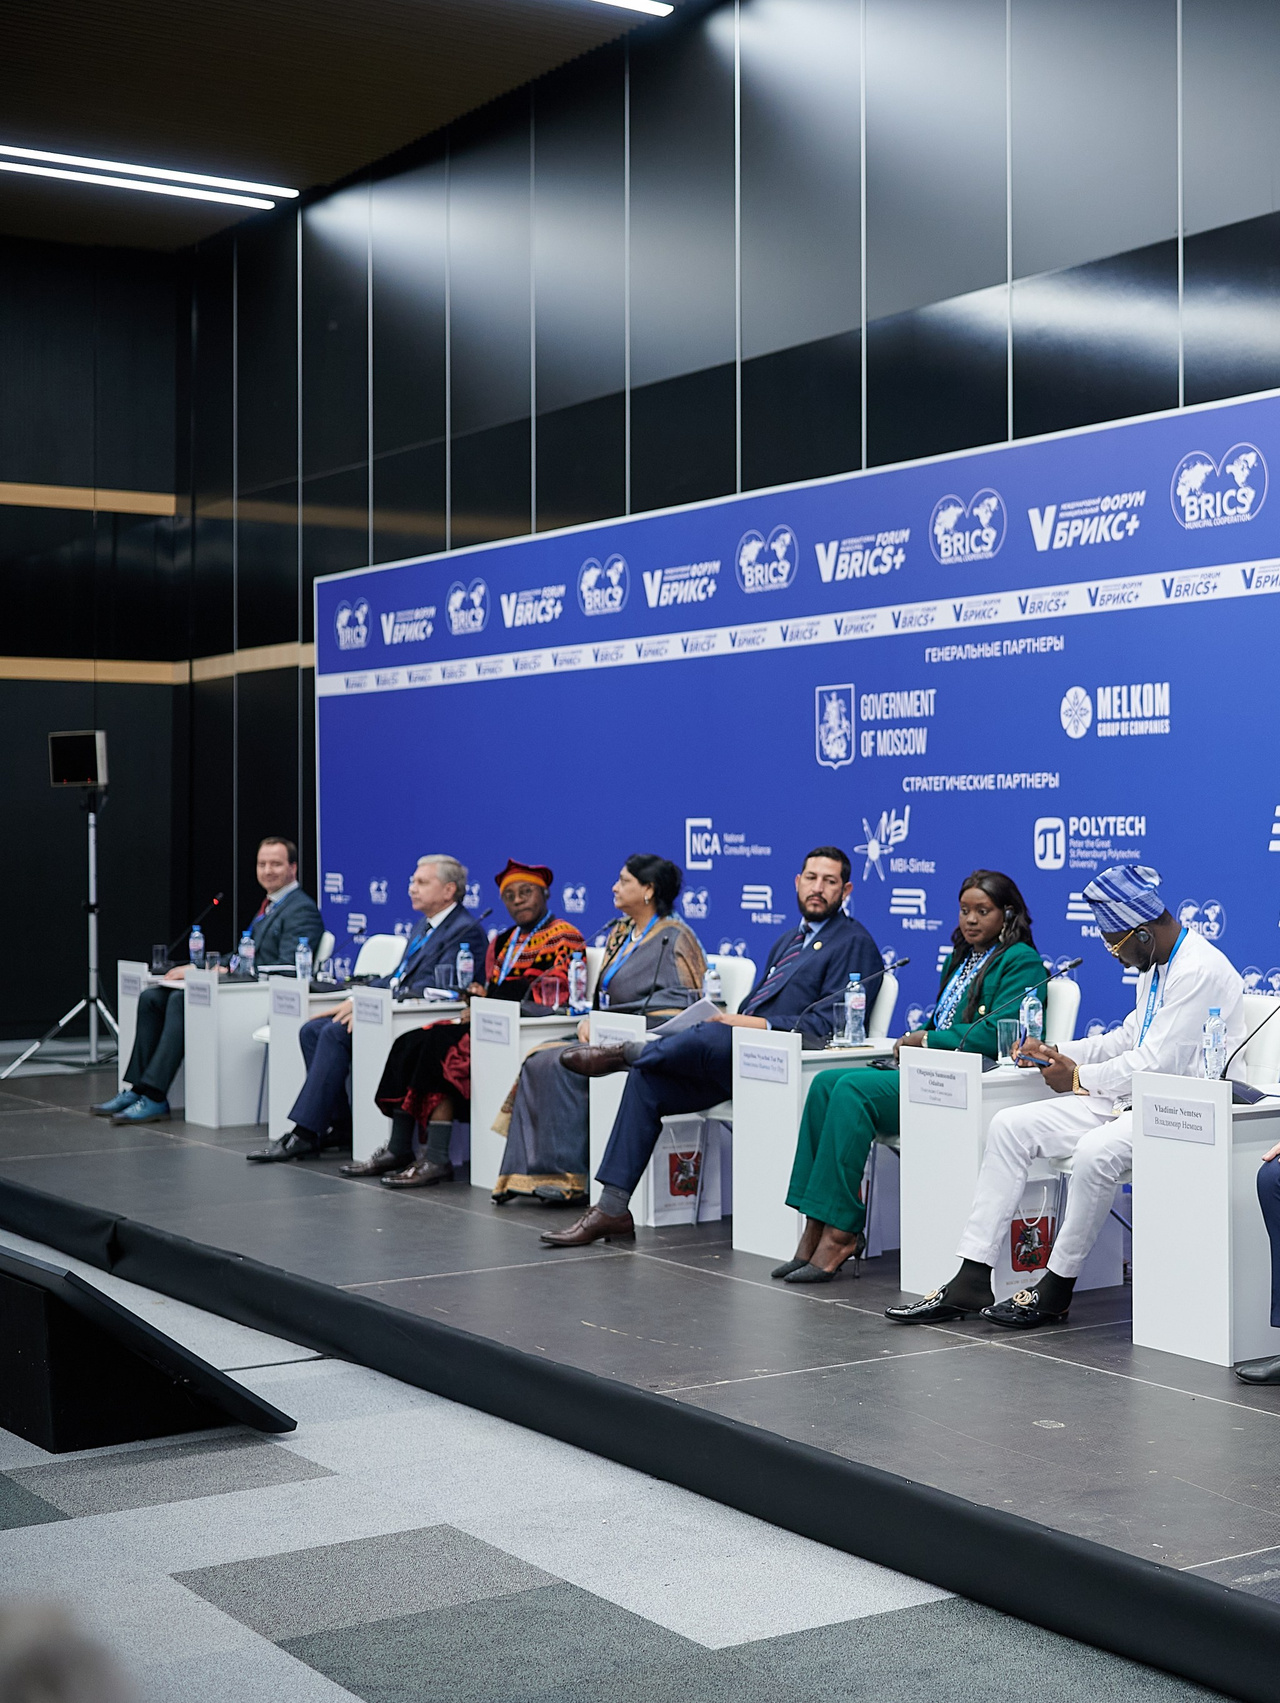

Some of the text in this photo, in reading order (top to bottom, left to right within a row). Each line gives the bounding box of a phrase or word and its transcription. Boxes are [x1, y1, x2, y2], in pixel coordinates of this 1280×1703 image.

[1100, 489, 1146, 512] ФОРУМ
[1185, 486, 1252, 523] BRICS
[875, 527, 911, 548] FORUM
[940, 526, 994, 559] BRICS
[1027, 504, 1056, 552] V
[1053, 511, 1139, 550] БРИКС+
[745, 558, 789, 588] BRICS
[814, 540, 839, 583] V
[835, 544, 905, 582] BRICS+
[642, 569, 663, 608] V
[659, 576, 717, 607] БРИКС+
[514, 596, 563, 628] BRICS+
[925, 635, 1064, 662] ГЕНЕРАЛЬНЫЕ ПАРТНЕРЫ
[861, 689, 937, 721] GOVERNMENT
[1097, 682, 1170, 720] MELKOM
[861, 727, 928, 757] OF MOSCOW
[1097, 718, 1170, 737] GROUP OF COMPANIES
[902, 772, 1060, 792] СТРАТЕГИЧЕСКИЕ ПАРТНЕРЫ
[1069, 816, 1146, 836] POLYTECH
[692, 833, 721, 855] NCA
[1154, 1104, 1202, 1119] Vladimir Nemtsev
